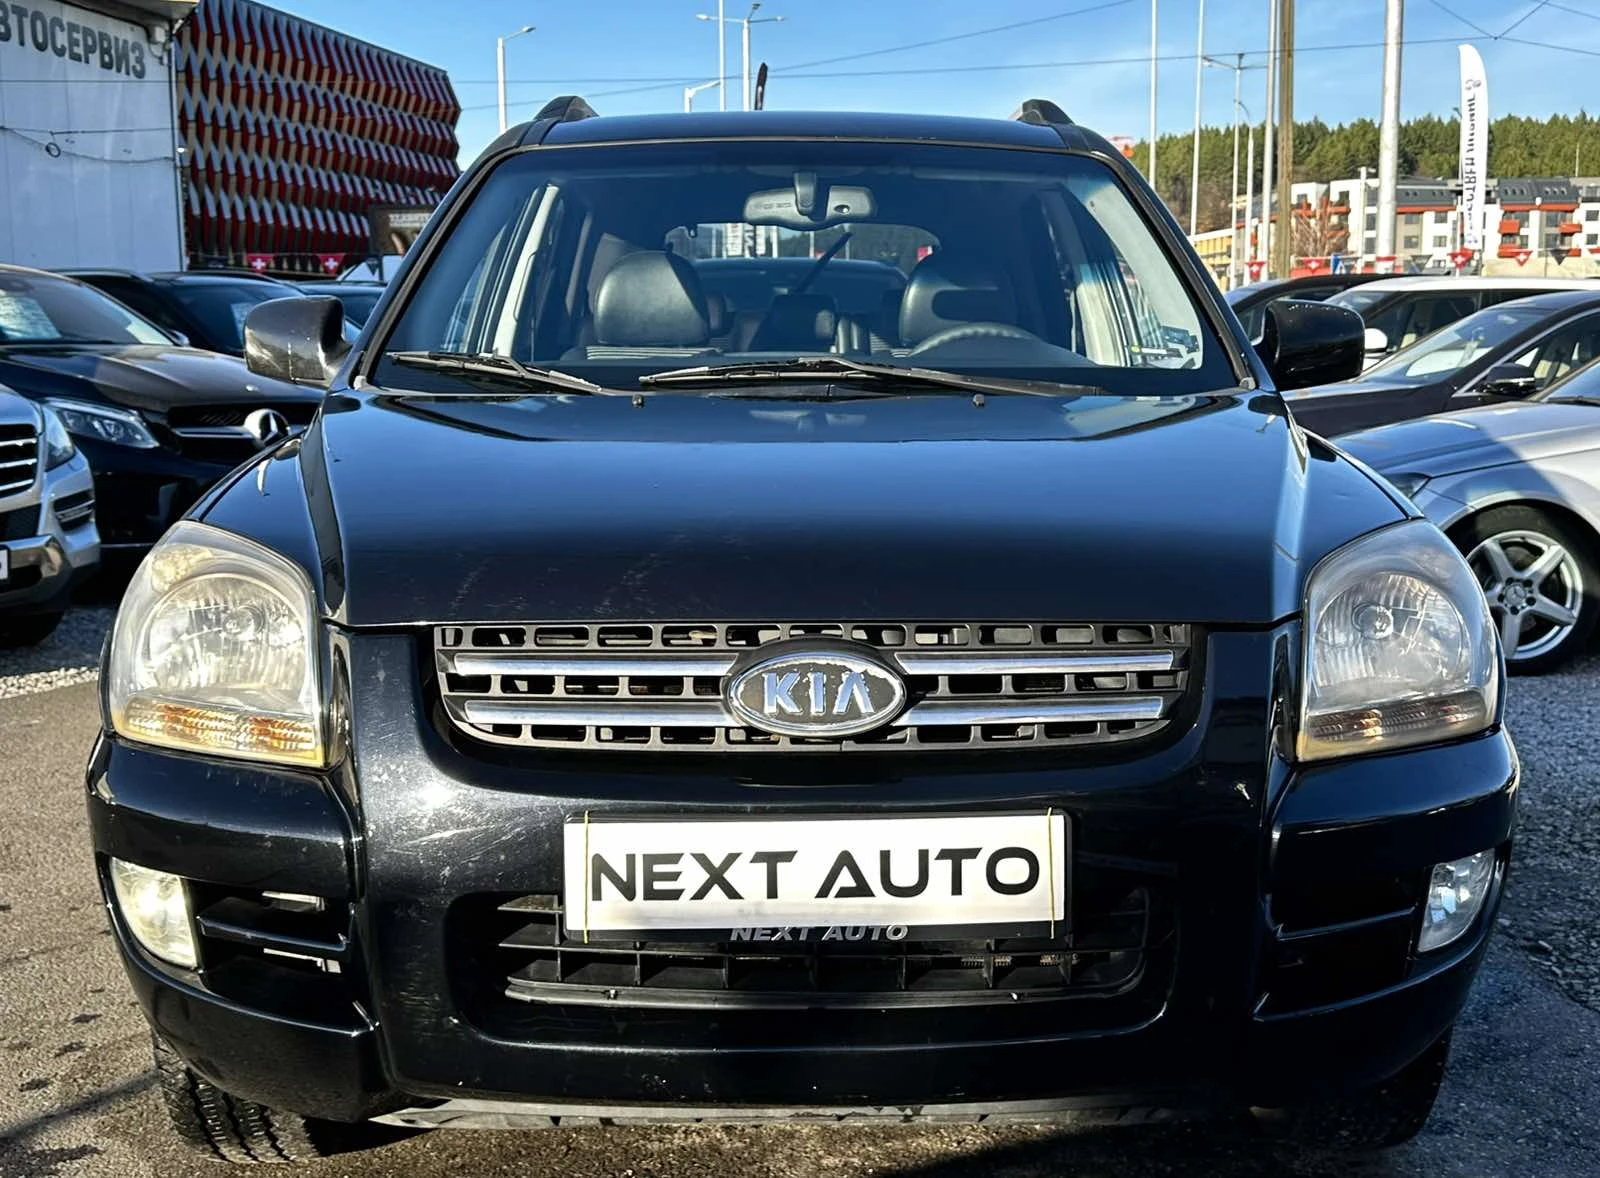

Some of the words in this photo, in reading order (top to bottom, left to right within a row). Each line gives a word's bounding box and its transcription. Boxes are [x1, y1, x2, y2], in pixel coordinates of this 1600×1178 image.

[762, 671, 875, 717] KIA
[591, 849, 798, 902] NEXT
[814, 846, 1040, 899] AUTO
[730, 926, 815, 942] NEXT
[821, 924, 909, 941] AUTO
